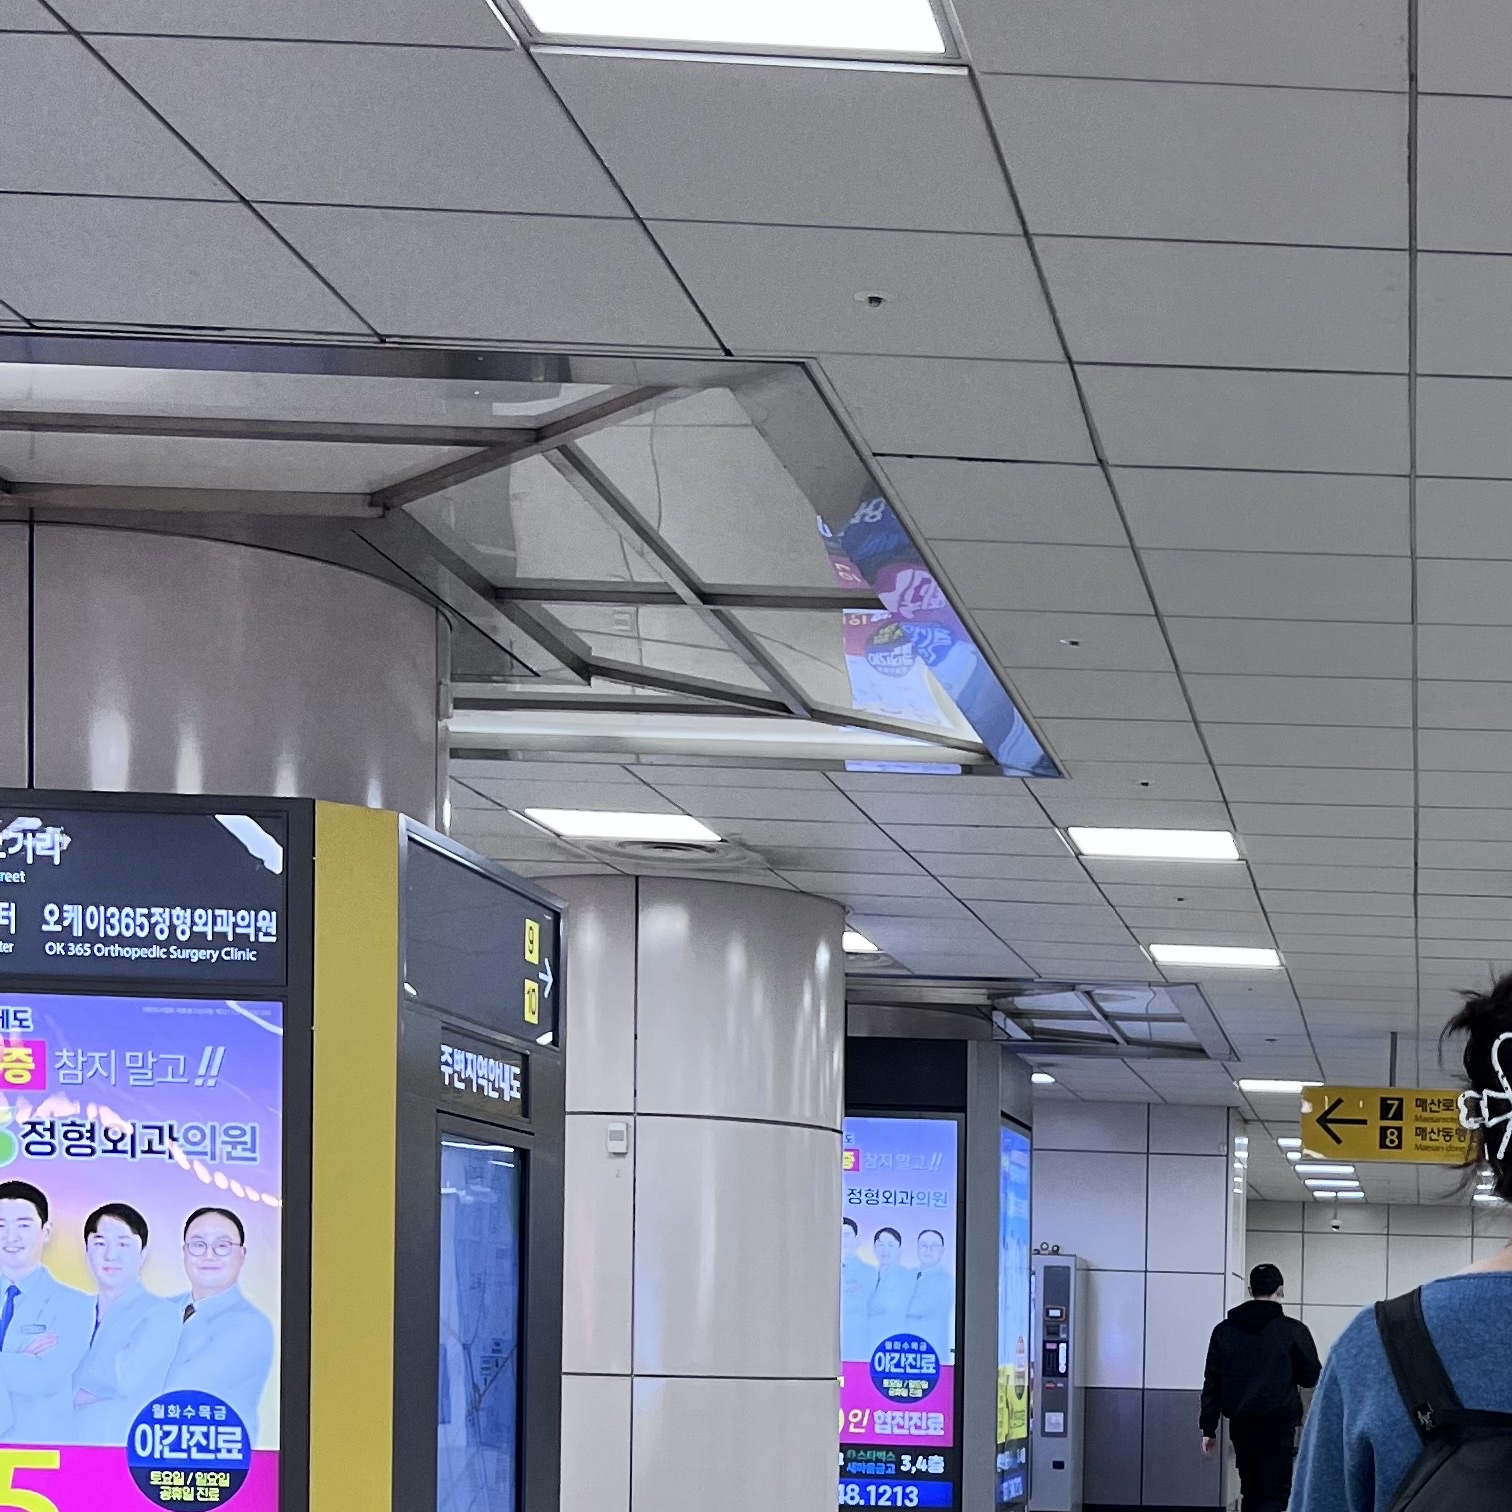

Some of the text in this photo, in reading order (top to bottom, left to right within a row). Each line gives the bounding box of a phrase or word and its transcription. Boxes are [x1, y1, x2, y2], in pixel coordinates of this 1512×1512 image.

[0, 832, 61, 866] 거리
[41, 903, 277, 943] 오케이365정형외과의원
[45, 942, 257, 963] OK 365 Orthopedic Surgery Clinic
[54, 1048, 117, 1087] 참지
[440, 1043, 522, 1101] 주변지역안내도
[1386, 1099, 1400, 1119] 7
[1415, 1098, 1459, 1114] 매산로
[20, 1119, 259, 1163] 정형외과의원
[1385, 1128, 1399, 1147] 8
[847, 1188, 948, 1208] 정형외과의원
[874, 1351, 937, 1374] 야간진료
[873, 1409, 945, 1436] 협진진료
[134, 1423, 243, 1461] 야간진료
[900, 1454, 945, 1475] 3,4층
[149, 1470, 185, 1486] 토요일
[194, 1471, 230, 1488] 일요일
[196, 1486, 220, 1502] 진료
